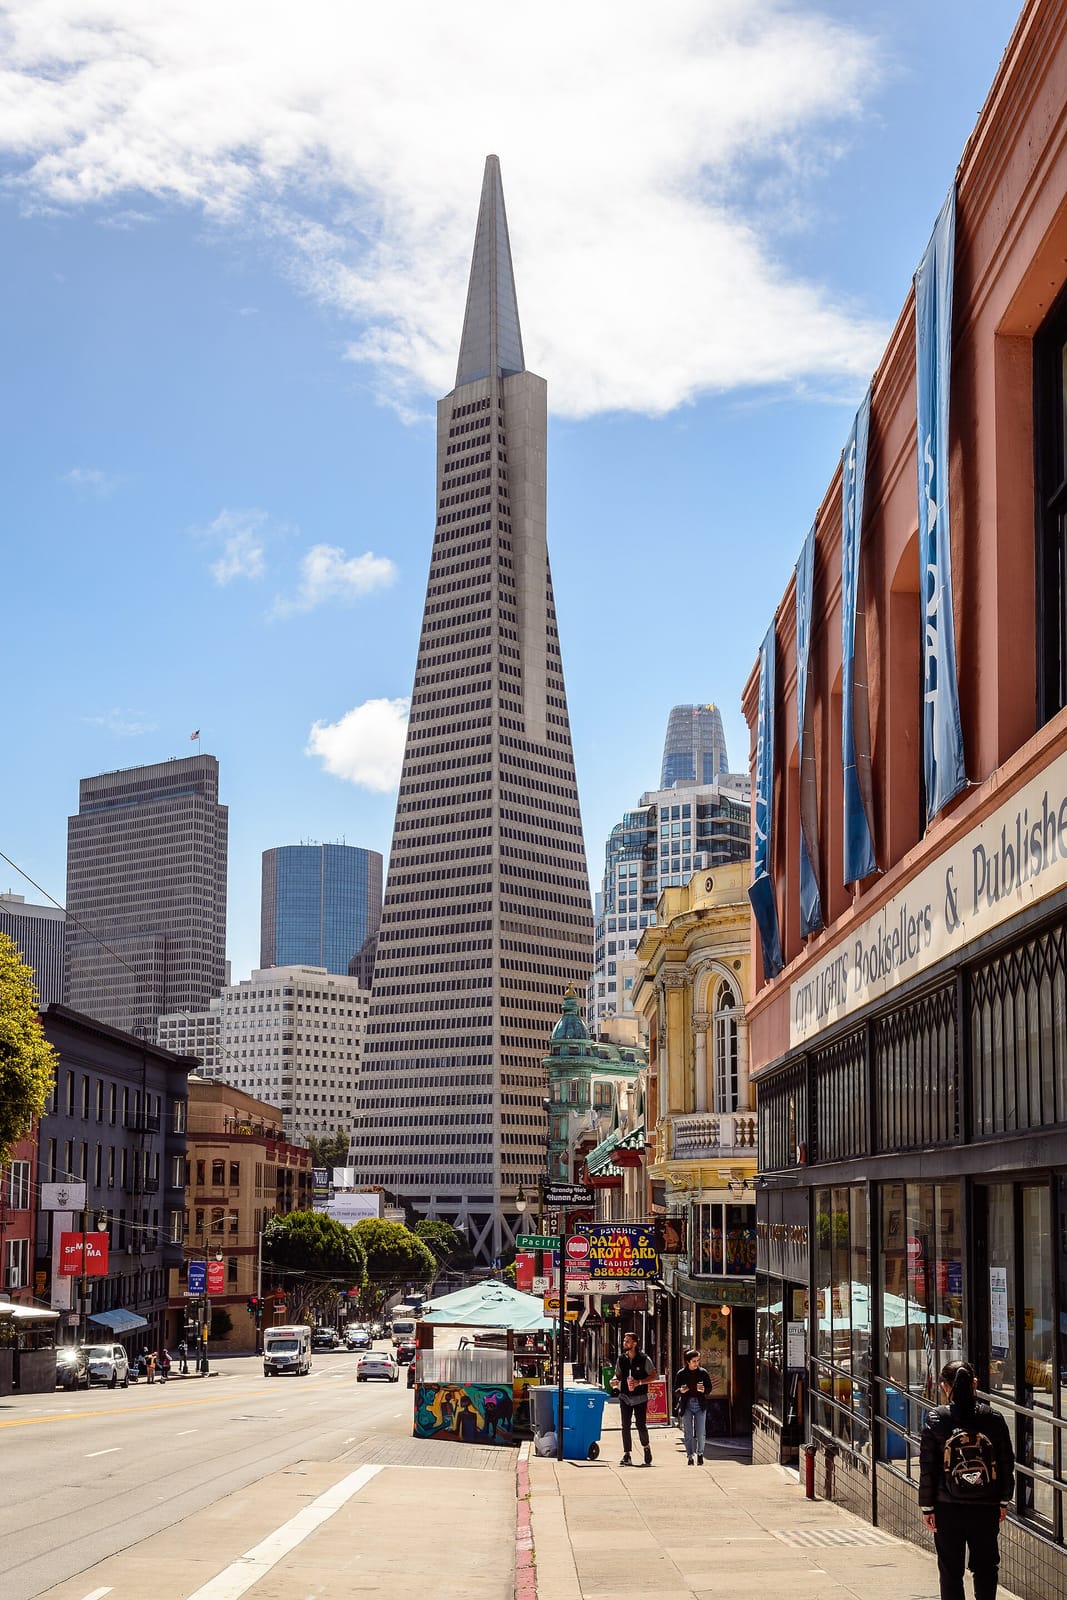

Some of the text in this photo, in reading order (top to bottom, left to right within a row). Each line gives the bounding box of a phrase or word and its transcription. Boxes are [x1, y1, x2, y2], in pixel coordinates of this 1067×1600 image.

[795, 790, 1067, 1034] CITY LIGHTS Booksellers & Publishe
[572, 1194, 591, 1202] Food
[600, 1227, 638, 1236] PSYCHIC
[589, 1235, 650, 1247] PALM &
[589, 1248, 656, 1259] AROT CARD
